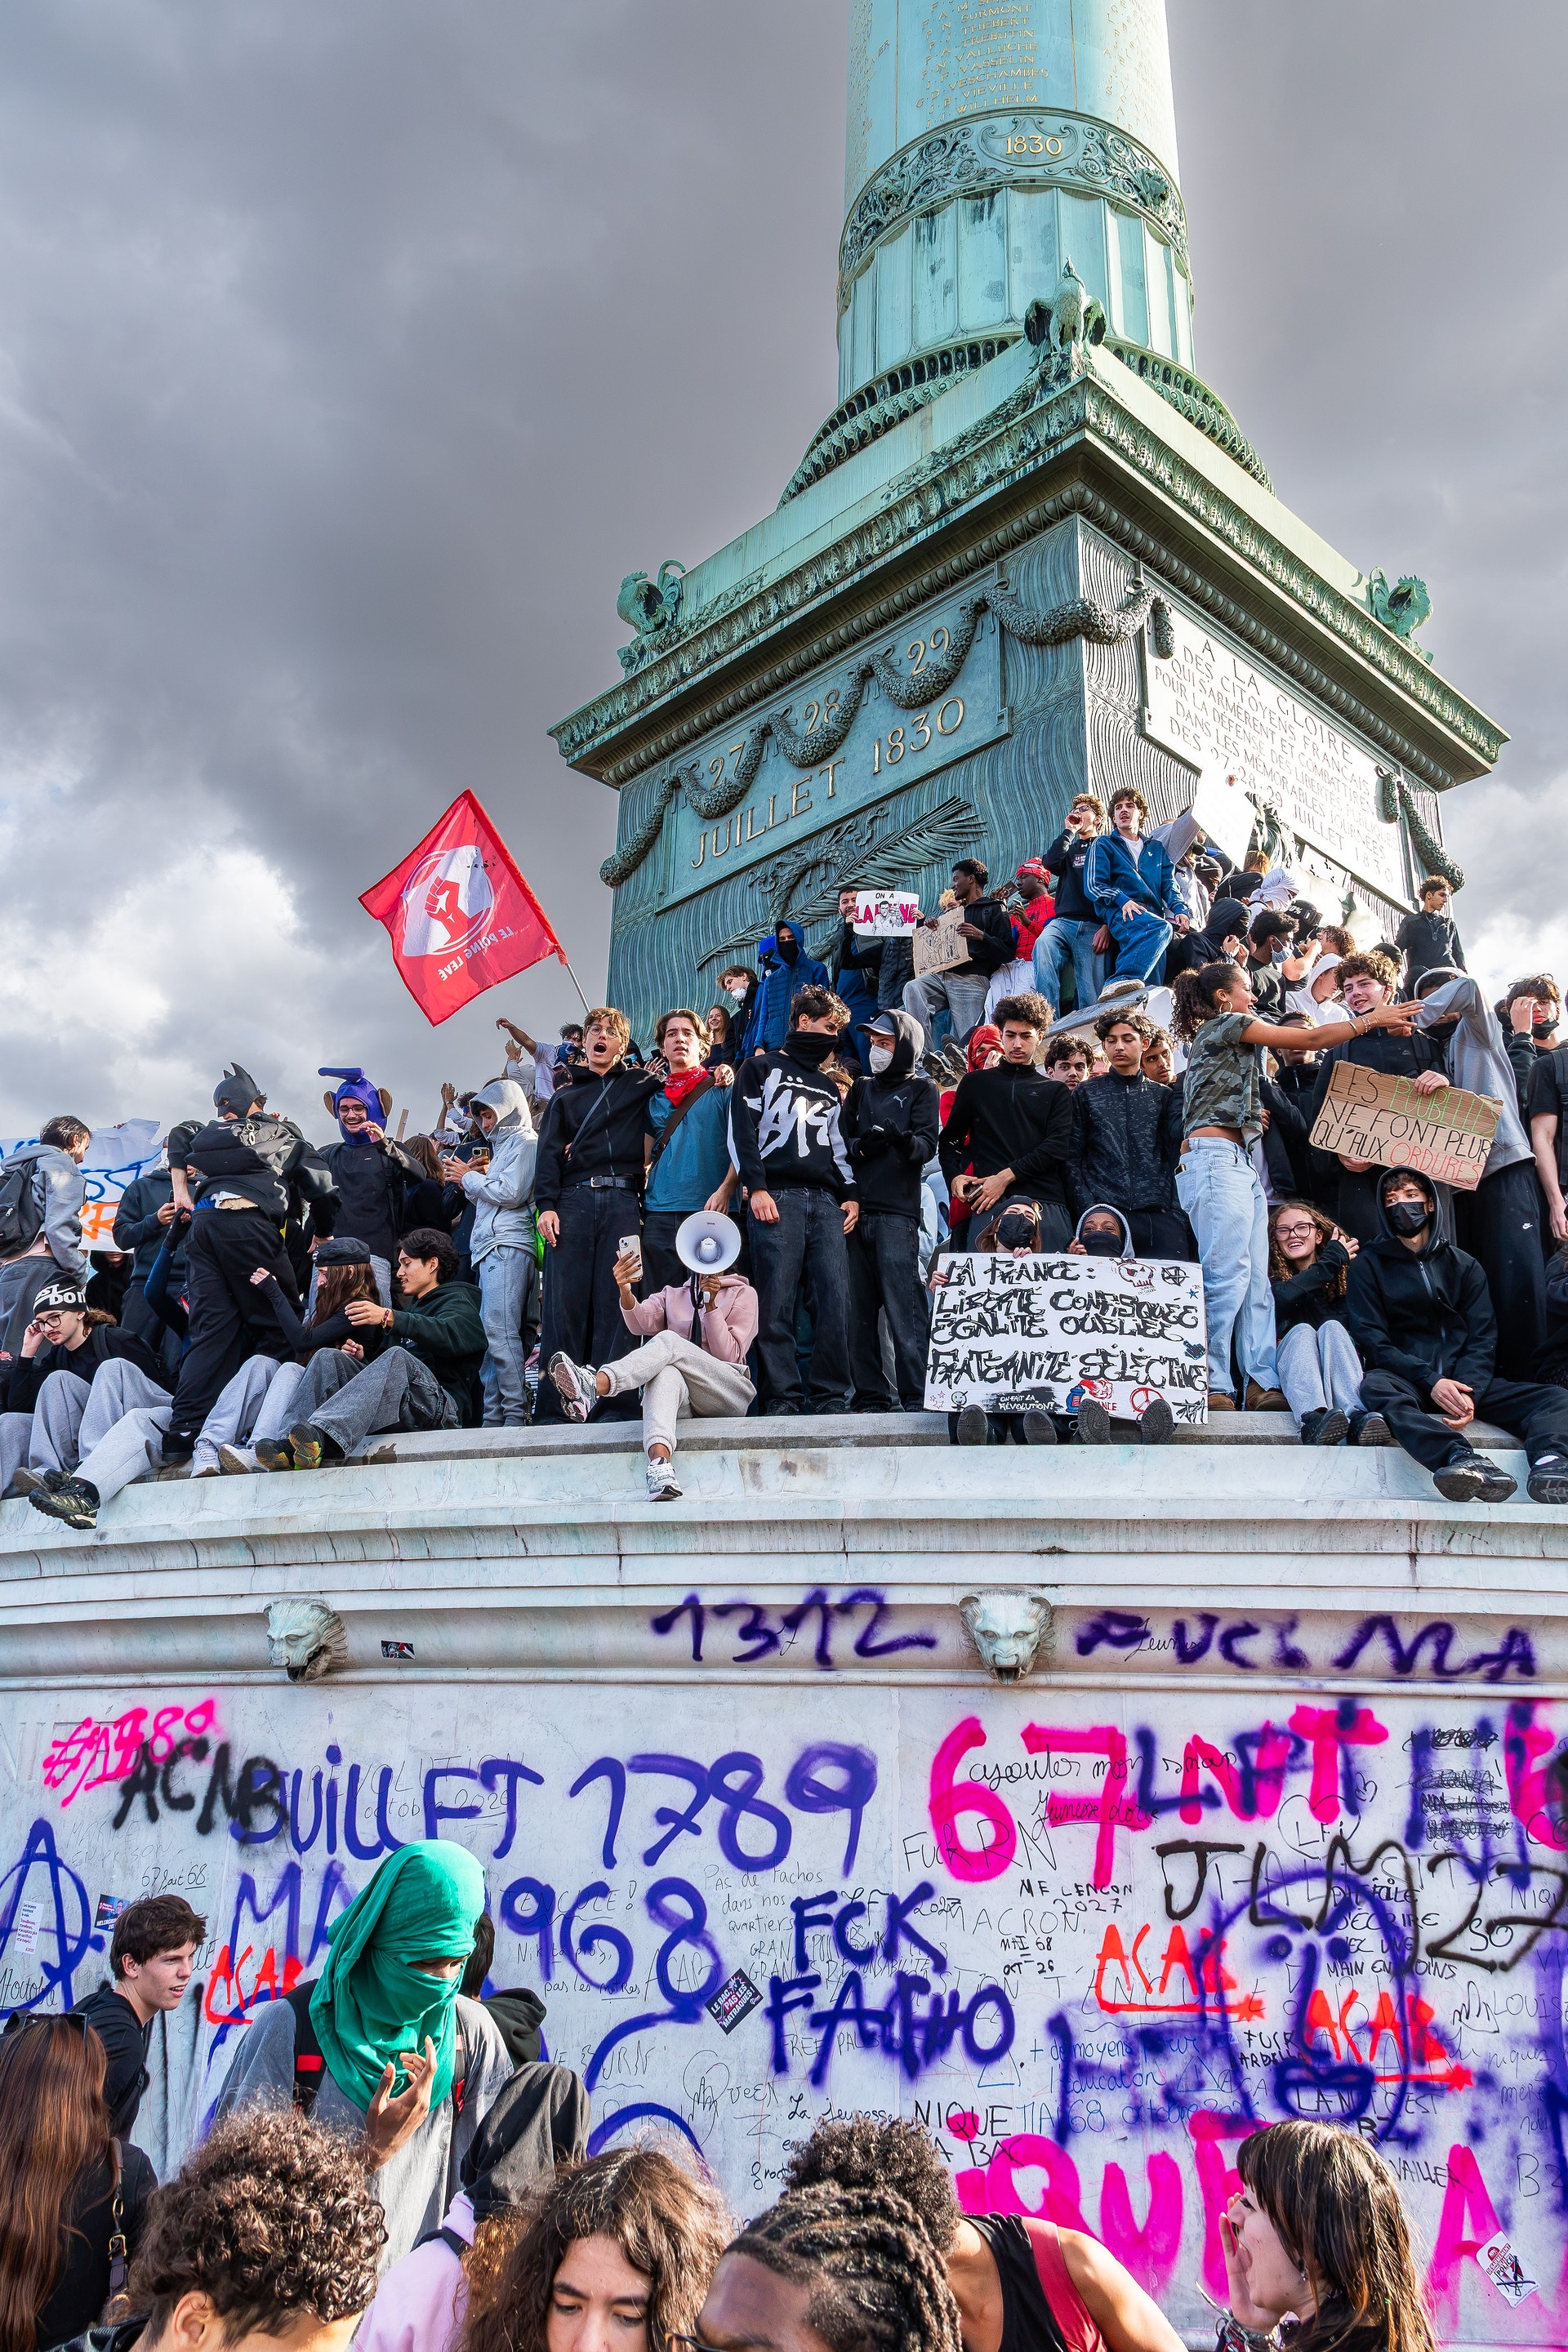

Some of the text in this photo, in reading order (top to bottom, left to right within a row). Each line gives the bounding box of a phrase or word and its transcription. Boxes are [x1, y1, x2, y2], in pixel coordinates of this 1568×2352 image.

[960, 4, 1032, 24] SURMONT
[955, 42, 1039, 62] VALLUCHE
[960, 55, 1035, 74] VASSELIN
[948, 68, 1049, 91] VESCHAMBES
[956, 94, 1039, 114] WILLHELM
[1005, 136, 1062, 156] 1830
[707, 626, 950, 789] 27 28 29
[1155, 666, 1187, 702] POUR
[1192, 693, 1209, 716] LA
[1183, 645, 1214, 680] DES
[1220, 675, 1296, 742] CITOYENS
[1202, 639, 1353, 765] A LA GLOIRE
[1171, 658, 1195, 687] QUI
[1298, 752, 1376, 816] COMBATTIREN
[1175, 699, 1211, 737] DANS
[1216, 729, 1240, 757] LES
[691, 696, 965, 869] JUILLET 1830
[1169, 716, 1201, 751] DES
[1293, 804, 1344, 851] JUILLET
[1330, 1067, 1498, 1134] LES POUBELLES
[1313, 1120, 1483, 1184] QU'AUX ORDURES
[1319, 1096, 1490, 1161] NE FONT PEUR
[942, 1257, 1080, 1287] LA FRANCE
[651, 1588, 936, 1666] 1312
[569, 1748, 879, 1878] 1789
[929, 1717, 1127, 1891] 67
[976, 1817, 1057, 1872] RN
[186, 1864, 207, 1886] 68
[721, 1893, 786, 1916] dans nos
[790, 1881, 947, 1973] FCK
[1036, 1936, 1054, 1952] 68
[1326, 1962, 1364, 1977] MAIN
[915, 2100, 1013, 2139] NIQUE
[1066, 2099, 1105, 2134] 68
[967, 2136, 1026, 2168] BAC
